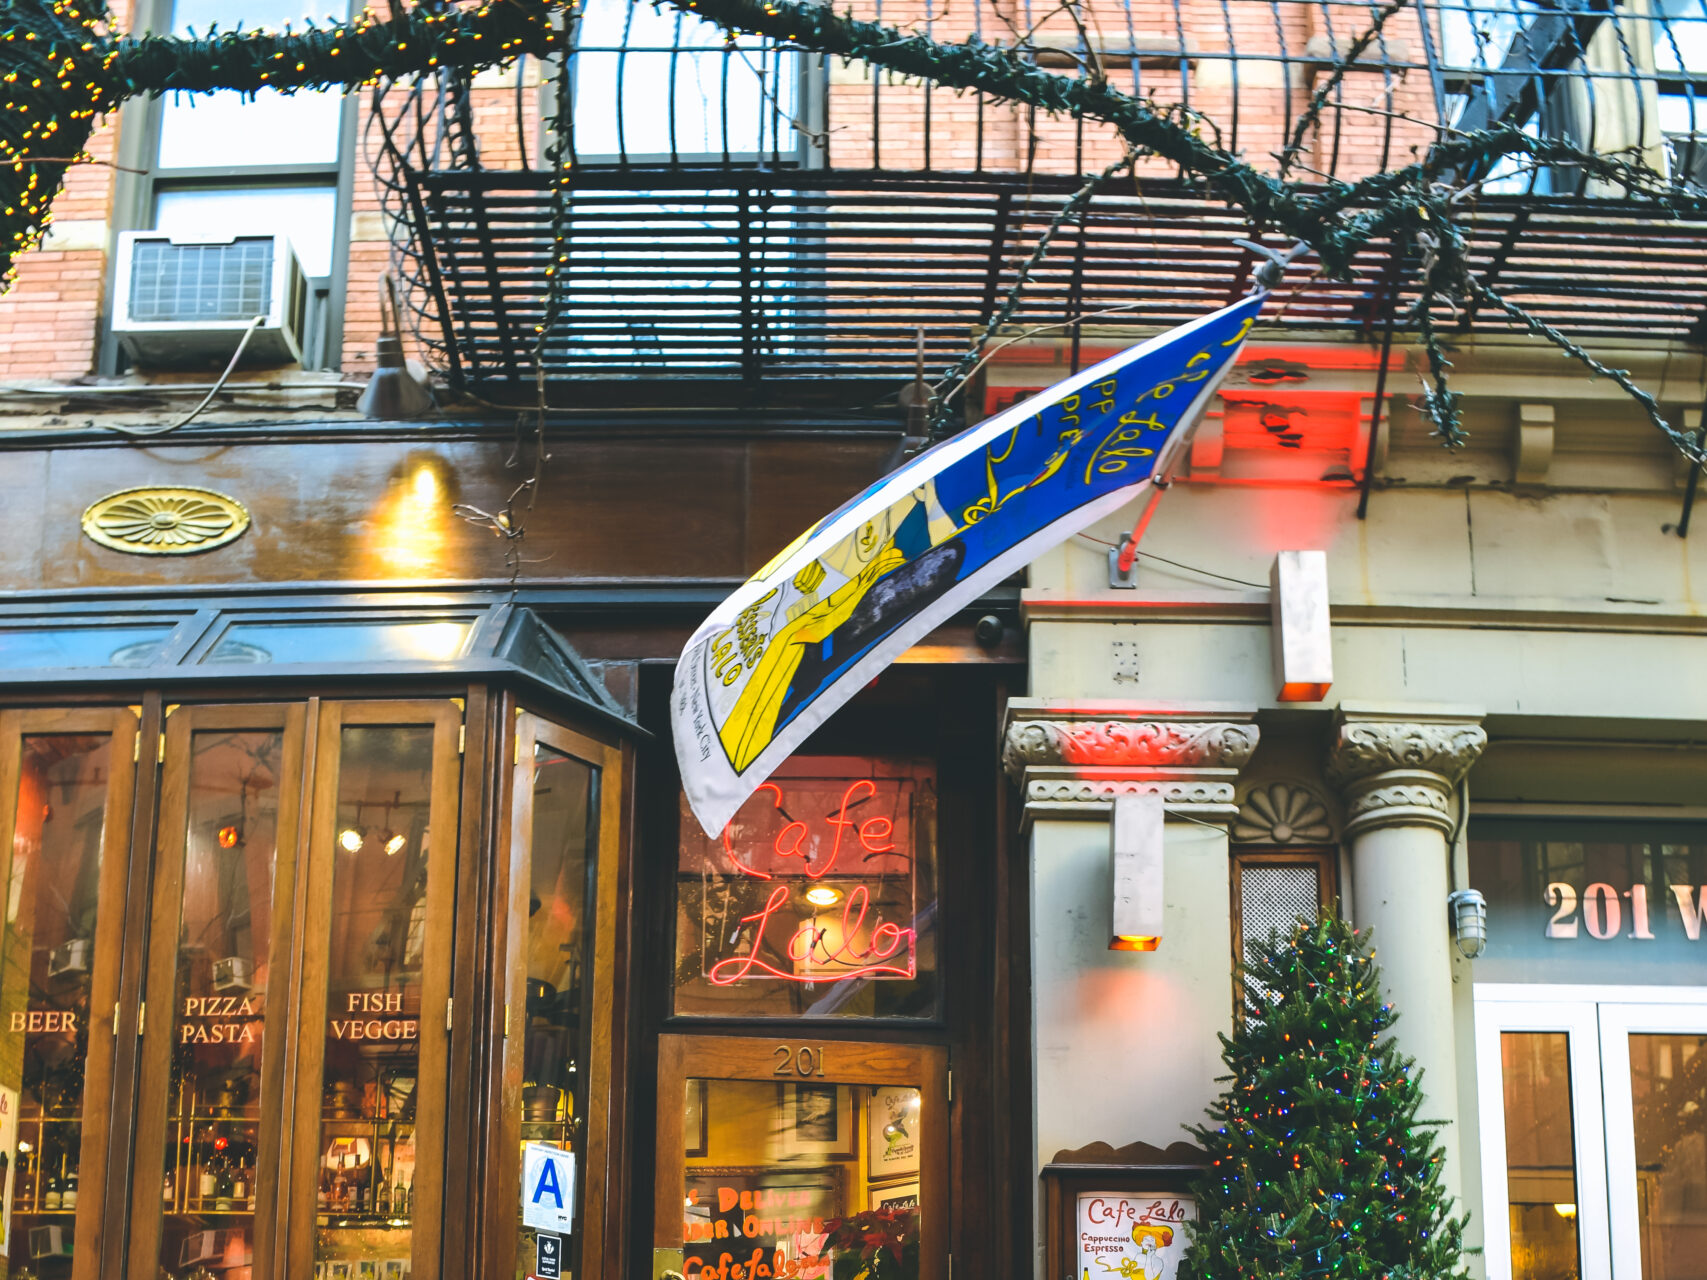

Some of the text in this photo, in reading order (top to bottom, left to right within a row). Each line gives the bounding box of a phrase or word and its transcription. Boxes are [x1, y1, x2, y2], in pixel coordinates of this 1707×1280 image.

[724, 779, 896, 879] Cafe
[1543, 882, 1656, 940] 201
[710, 885, 914, 984] Lalo
[184, 997, 254, 1017] PIZZA
[347, 992, 403, 1012] FISH
[9, 1011, 78, 1033] BEER
[181, 1023, 255, 1044] PASTA
[330, 1020, 417, 1040] VEGGE
[773, 1045, 825, 1077] 201
[532, 1157, 564, 1209] A
[1088, 1198, 1185, 1228] Cafe Lalo
